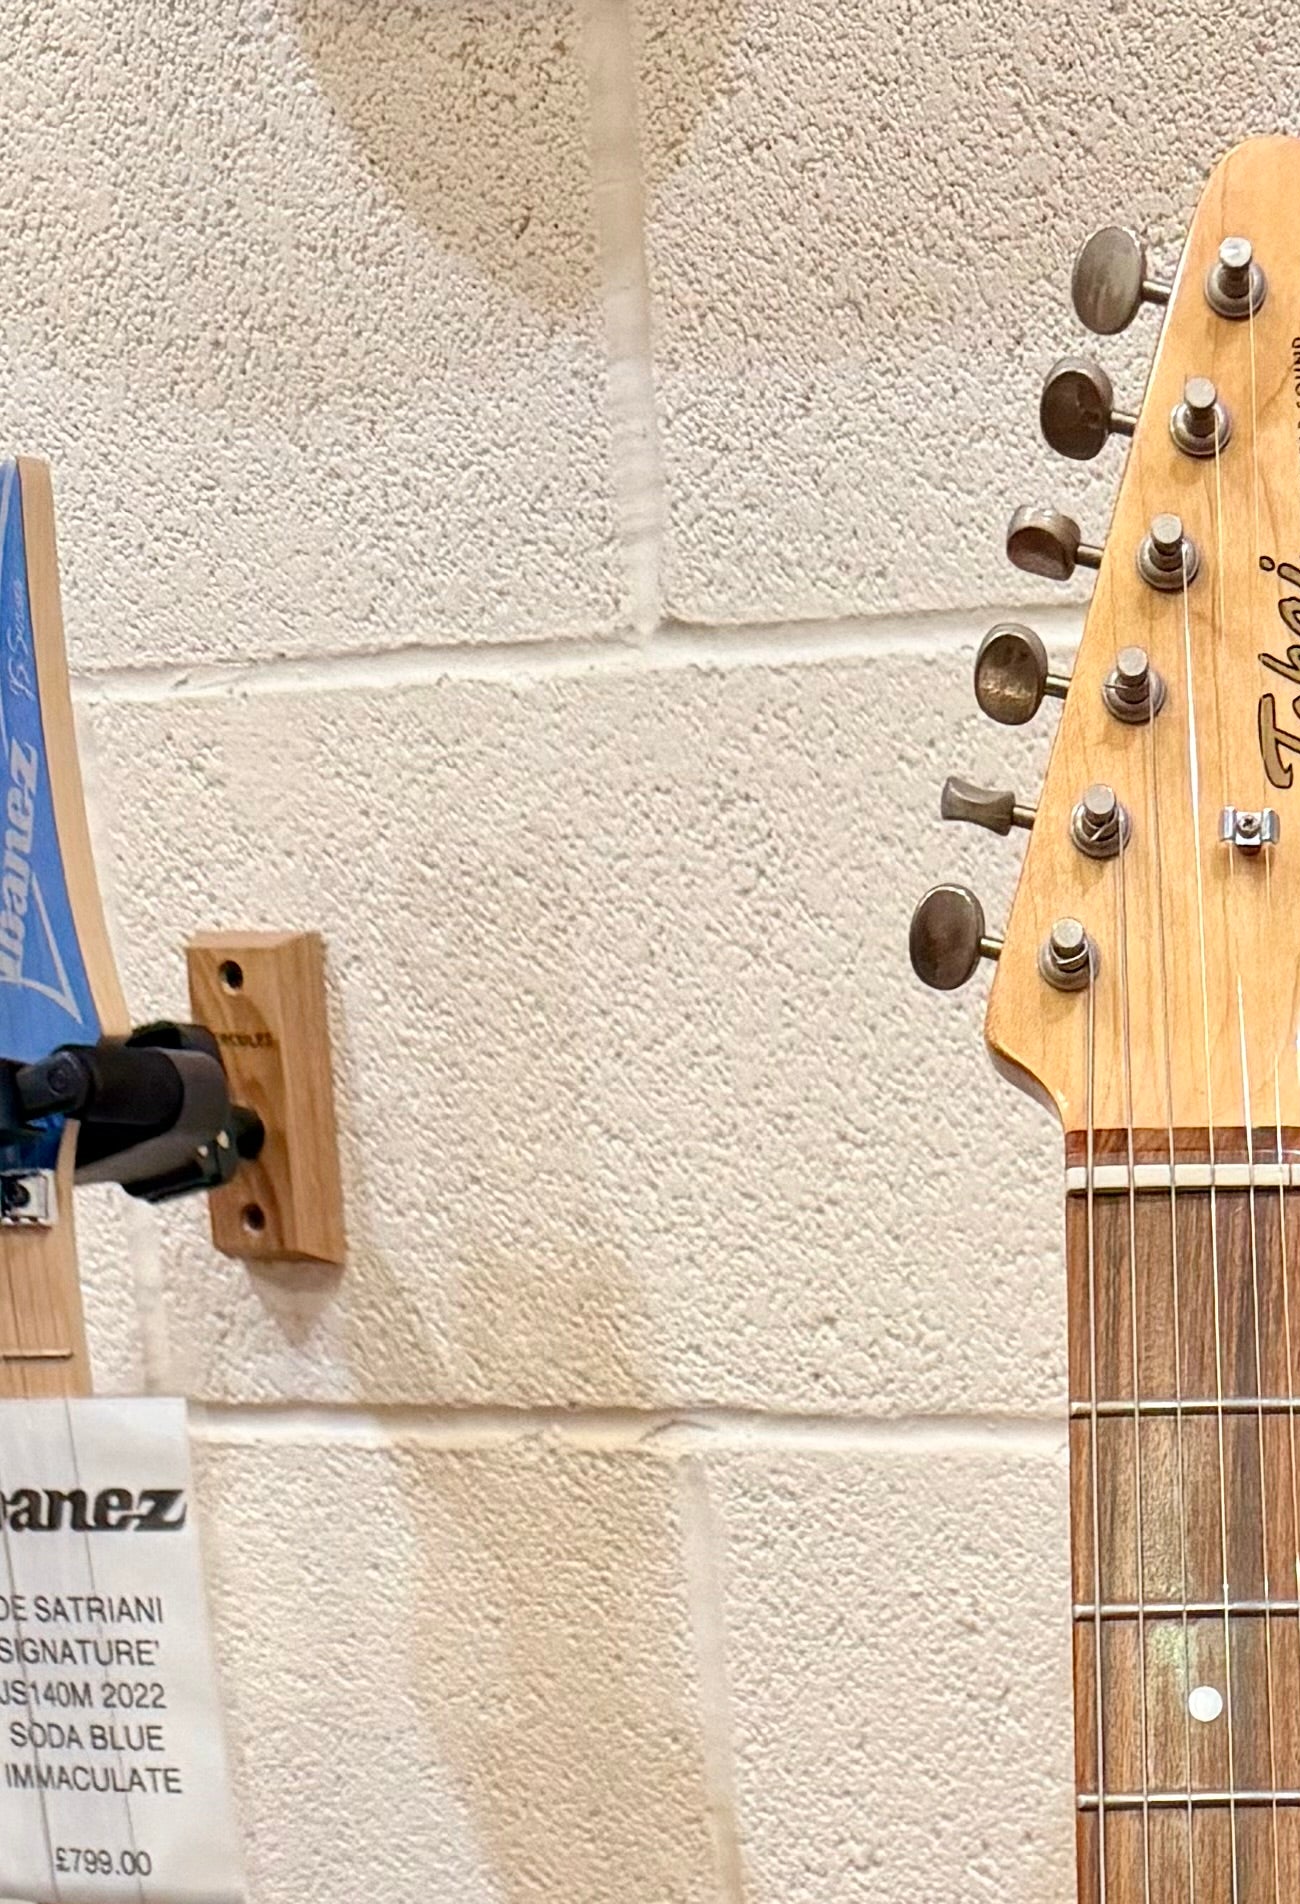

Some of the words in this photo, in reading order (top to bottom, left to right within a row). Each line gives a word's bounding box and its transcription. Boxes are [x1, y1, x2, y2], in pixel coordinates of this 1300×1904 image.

[34, 1595, 163, 1624] SATRIANI
[102, 1682, 167, 1710] 2022
[9, 1722, 83, 1751] SODA
[91, 1724, 165, 1753] BLUE
[5, 1764, 183, 1794] IMMACULATE
[56, 1847, 152, 1877] £799.00
